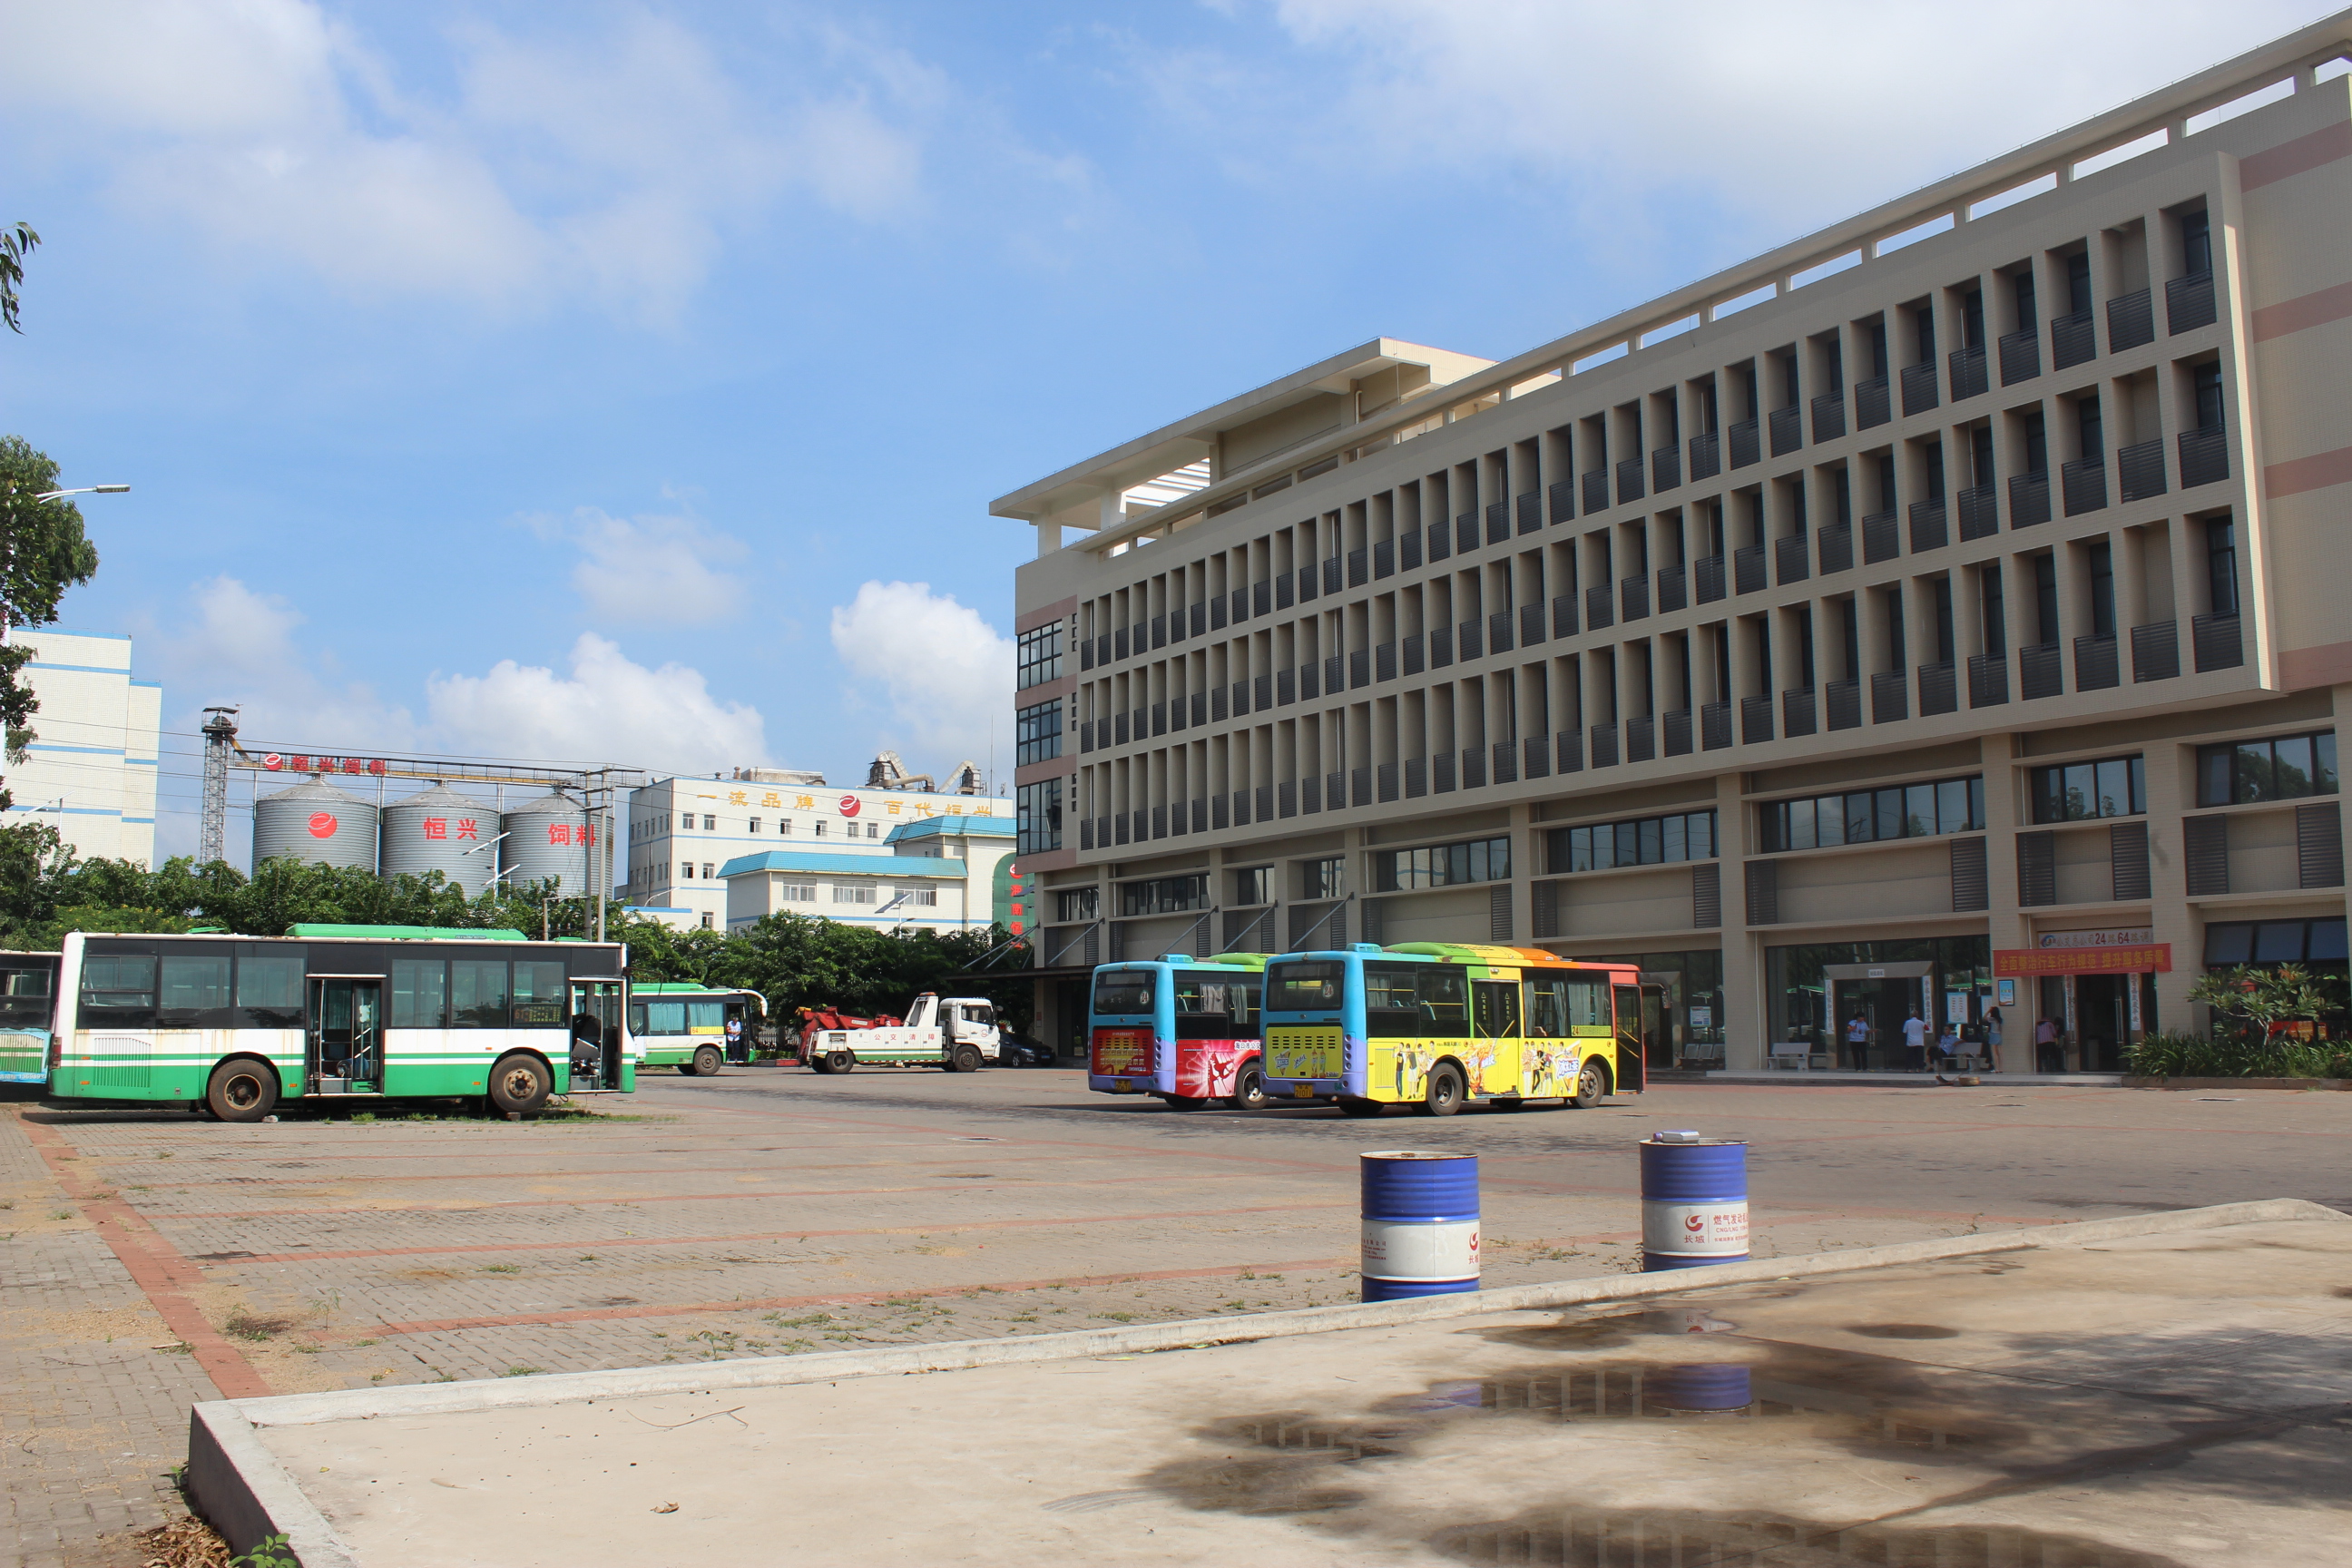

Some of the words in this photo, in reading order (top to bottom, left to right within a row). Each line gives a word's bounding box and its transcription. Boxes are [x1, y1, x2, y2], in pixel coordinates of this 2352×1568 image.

[291, 754, 387, 776] 恒兴饲料
[697, 790, 815, 810] 一流品牌
[423, 817, 478, 840] 恒兴
[547, 823, 596, 847] 饲料
[1324, 985, 1332, 995] 24
[1141, 992, 1148, 1002] 24
[1572, 1026, 1579, 1035] 24
[1684, 1235, 1705, 1243] 长城
